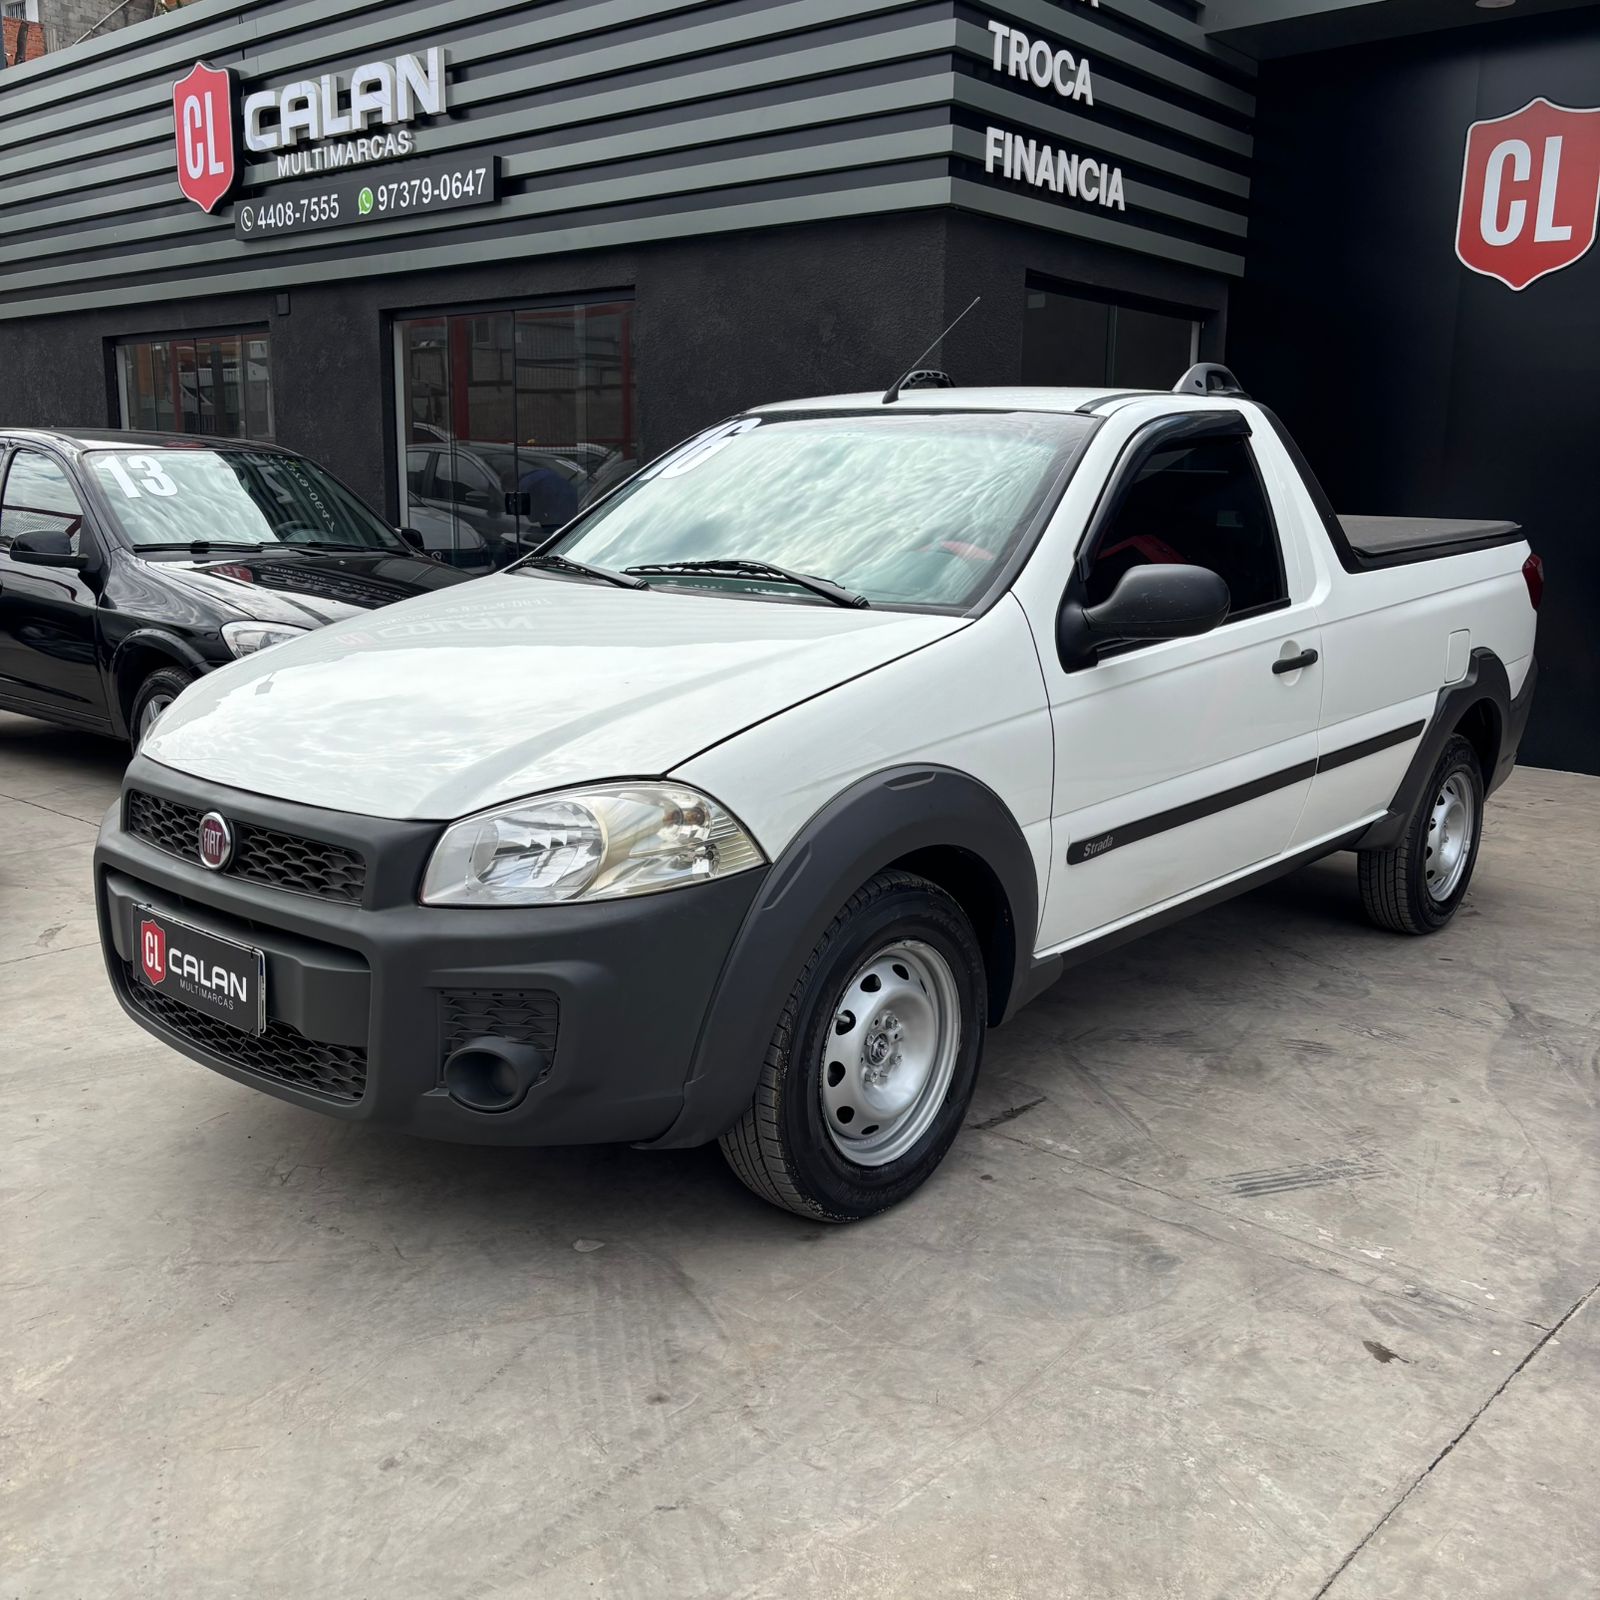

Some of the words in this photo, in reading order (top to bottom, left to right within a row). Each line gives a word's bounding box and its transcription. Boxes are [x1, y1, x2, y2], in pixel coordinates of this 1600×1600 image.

[987, 19, 1094, 106] TROCA
[243, 46, 446, 152] CALAN
[182, 90, 225, 180] CL
[277, 130, 413, 177] MULTIMARCAS
[985, 126, 1126, 211] FINANCIA
[1480, 135, 1573, 247] CL
[257, 194, 340, 230] 4408-7555
[377, 168, 487, 212] 97379-0647
[96, 454, 178, 499] 13
[203, 827, 222, 856] FIAT
[1083, 834, 1114, 858] Strada
[145, 931, 162, 972] CL
[168, 947, 247, 1003] CALAN
[180, 979, 234, 1011] MULTIMARCAS
